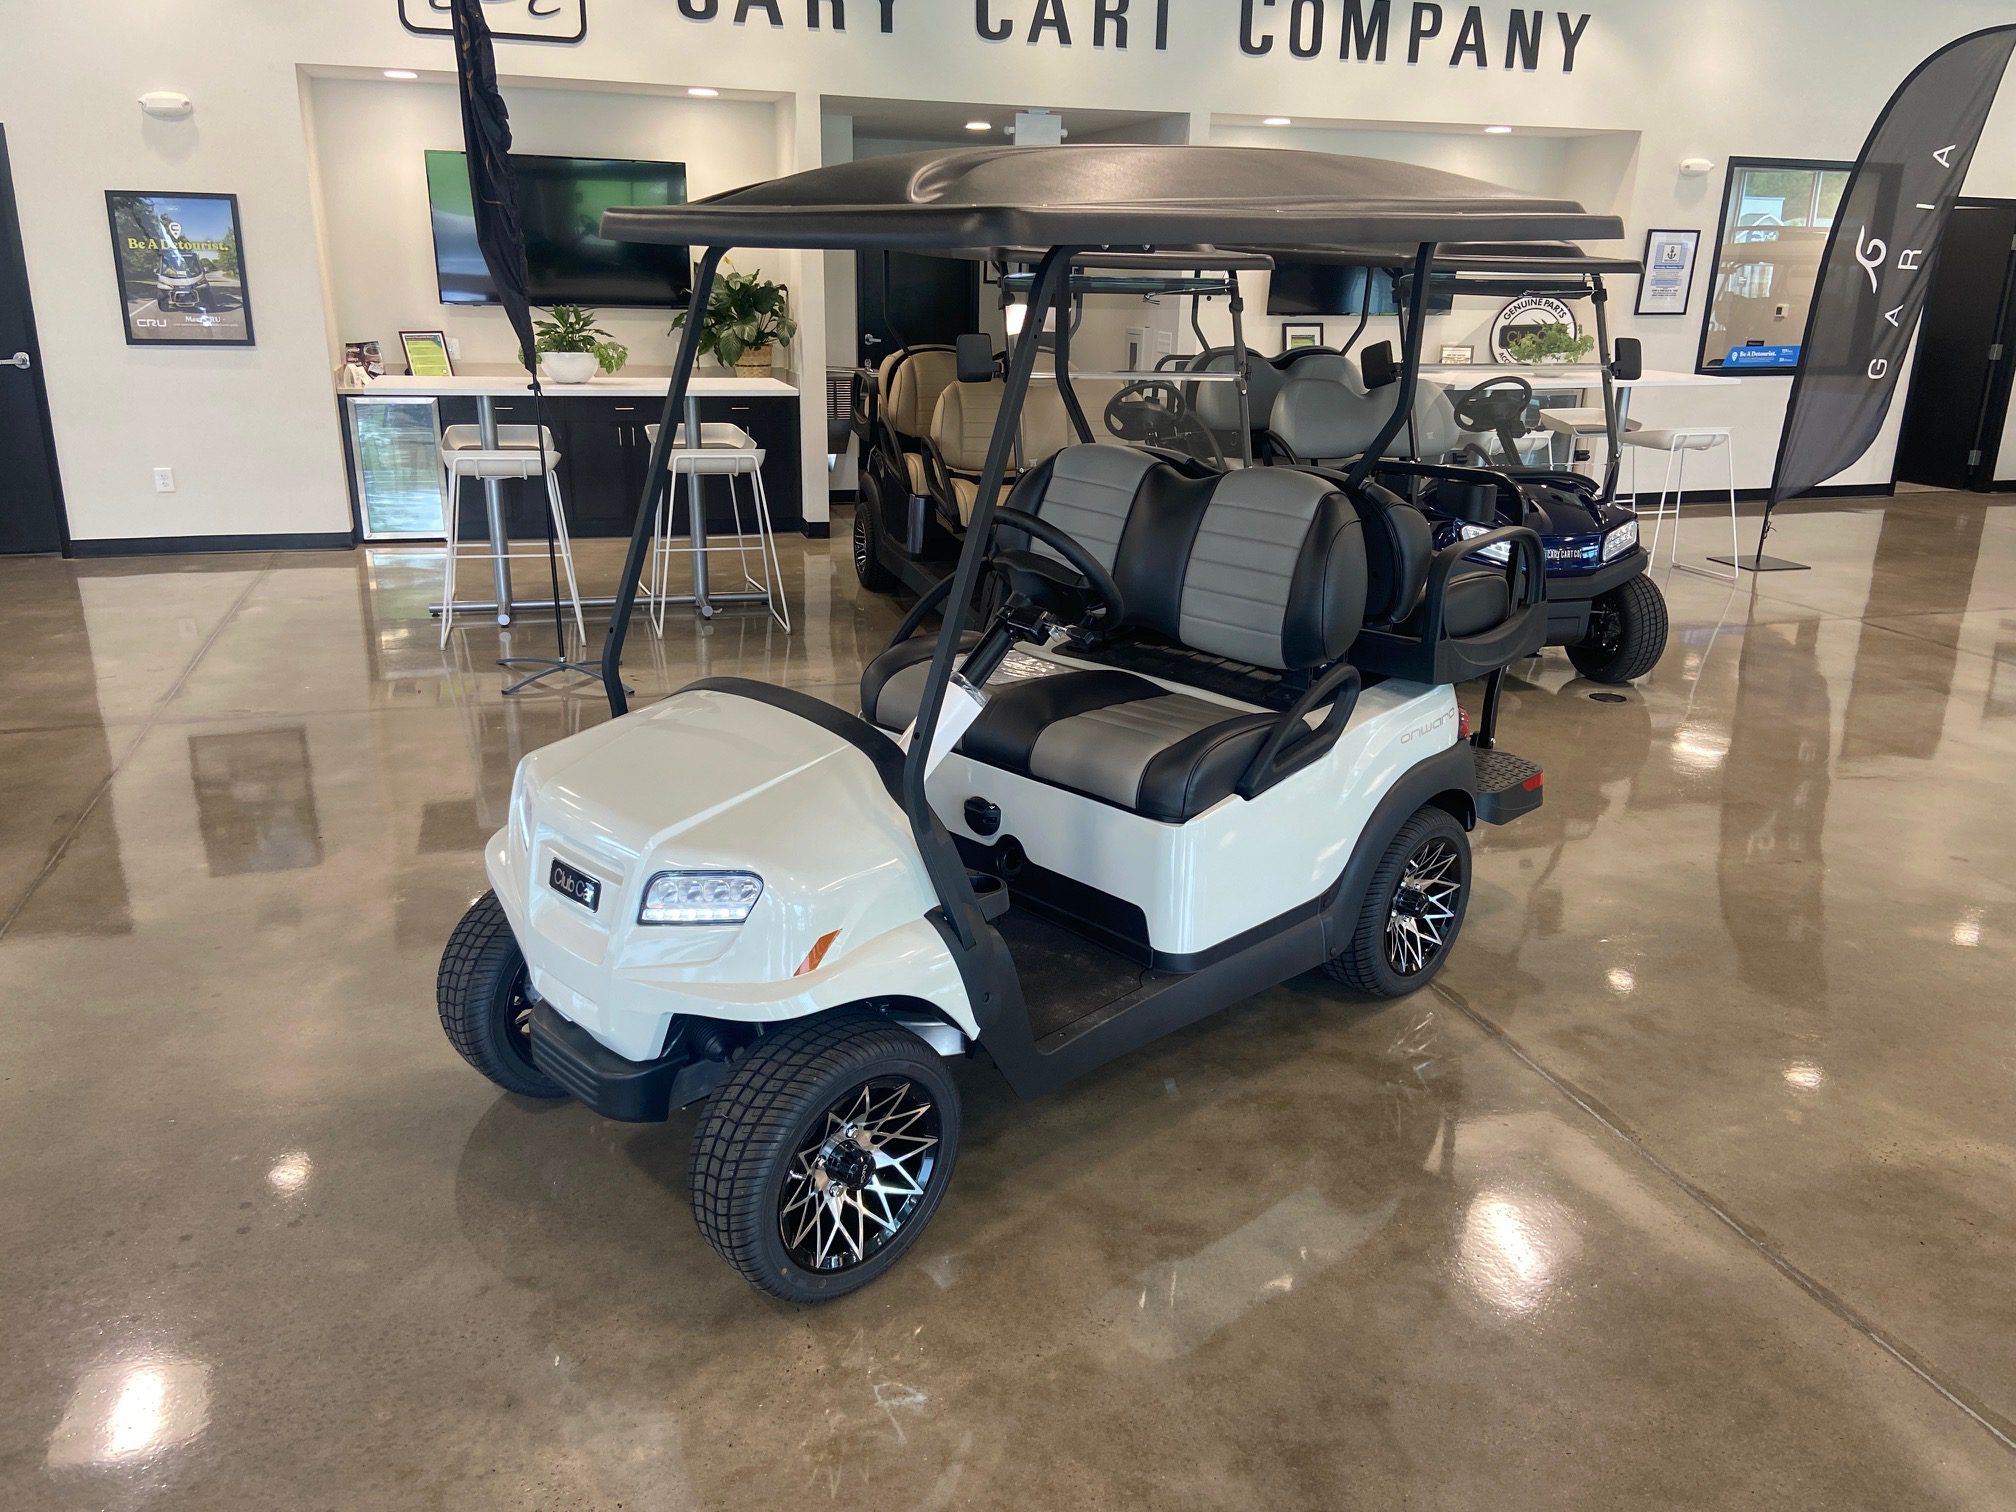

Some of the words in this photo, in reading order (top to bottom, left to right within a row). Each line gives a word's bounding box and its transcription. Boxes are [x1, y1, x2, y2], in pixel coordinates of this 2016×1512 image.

[1239, 0, 1591, 73] COMPANY
[128, 238, 146, 249] Be
[147, 238, 159, 250] A
[1867, 143, 1957, 380] GARIA
[1503, 298, 1544, 320] GENUINE
[1543, 299, 1567, 319] PARTS
[136, 319, 167, 327] CRU
[1561, 550, 1573, 558] CART
[554, 867, 575, 893] Club
